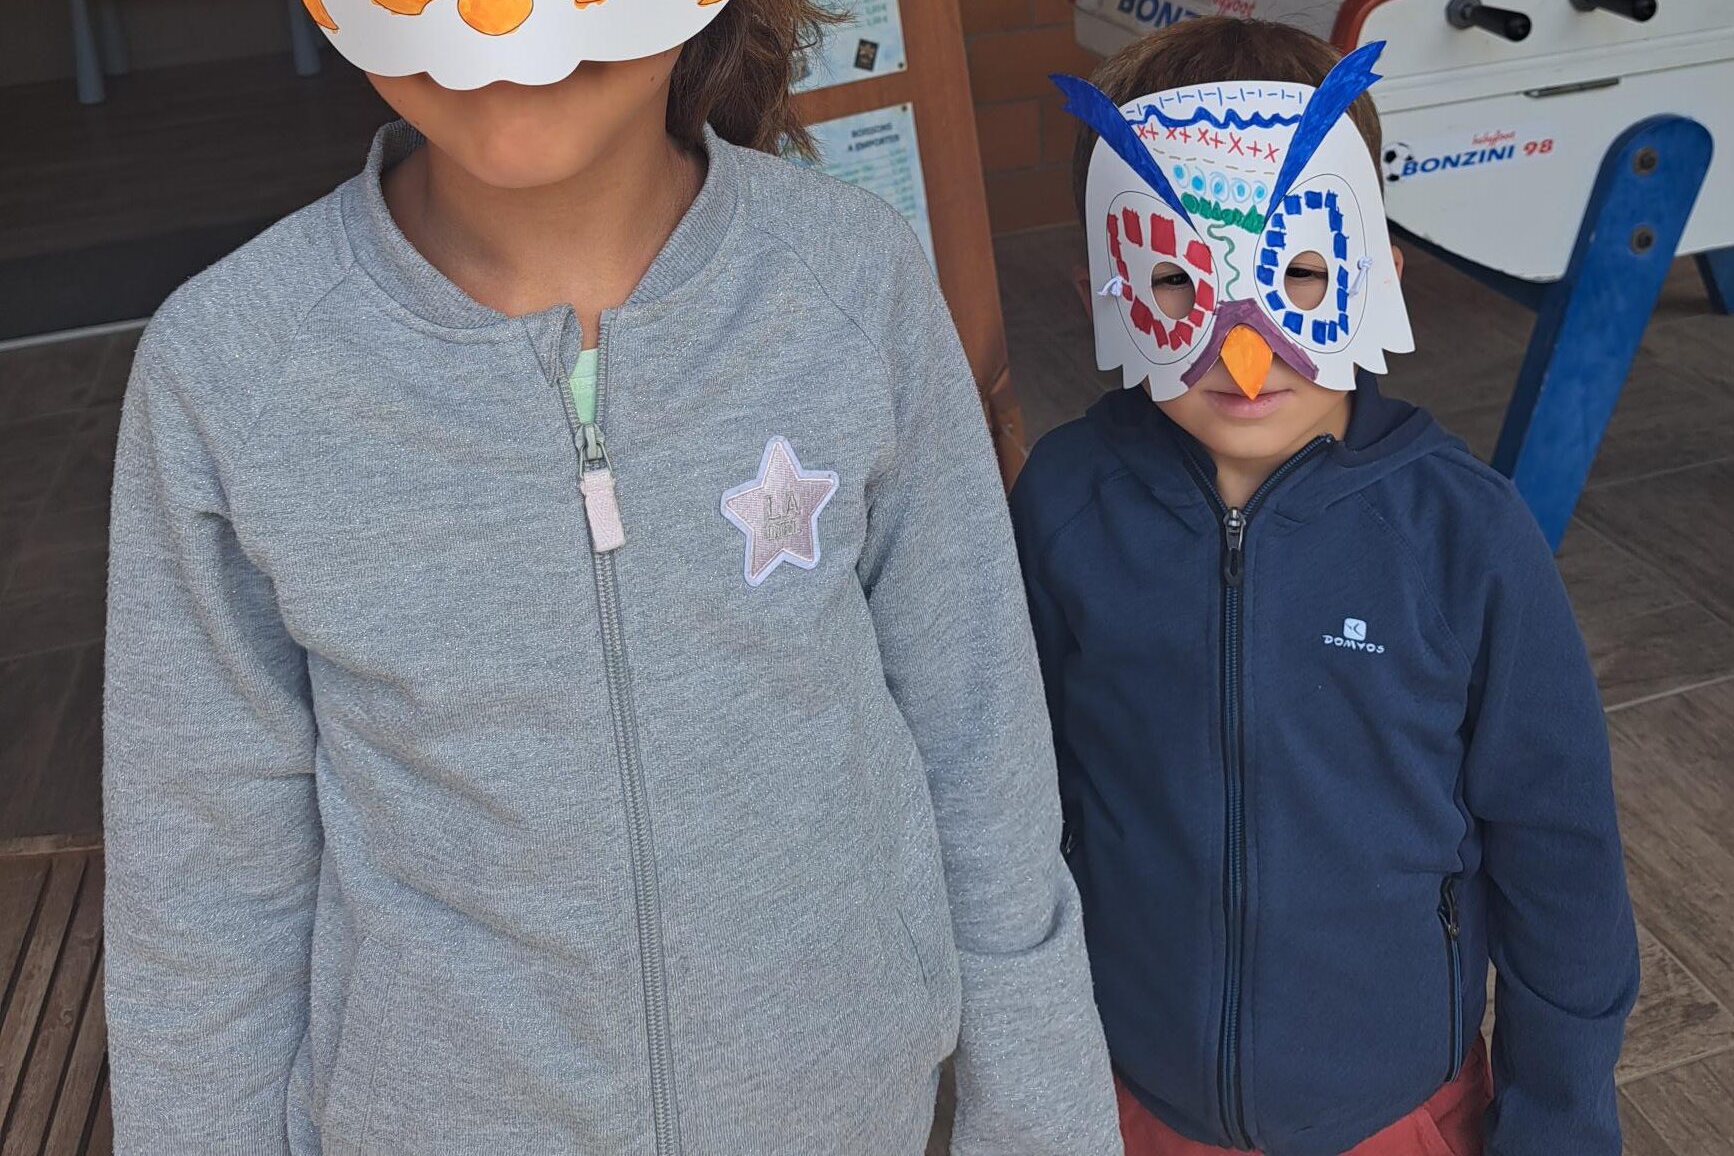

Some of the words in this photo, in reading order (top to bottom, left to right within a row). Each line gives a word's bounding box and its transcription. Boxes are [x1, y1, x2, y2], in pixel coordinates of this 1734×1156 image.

[1401, 145, 1515, 177] BONZINI
[1523, 139, 1554, 156] 98
[1322, 635, 1386, 654] DOMYOS
